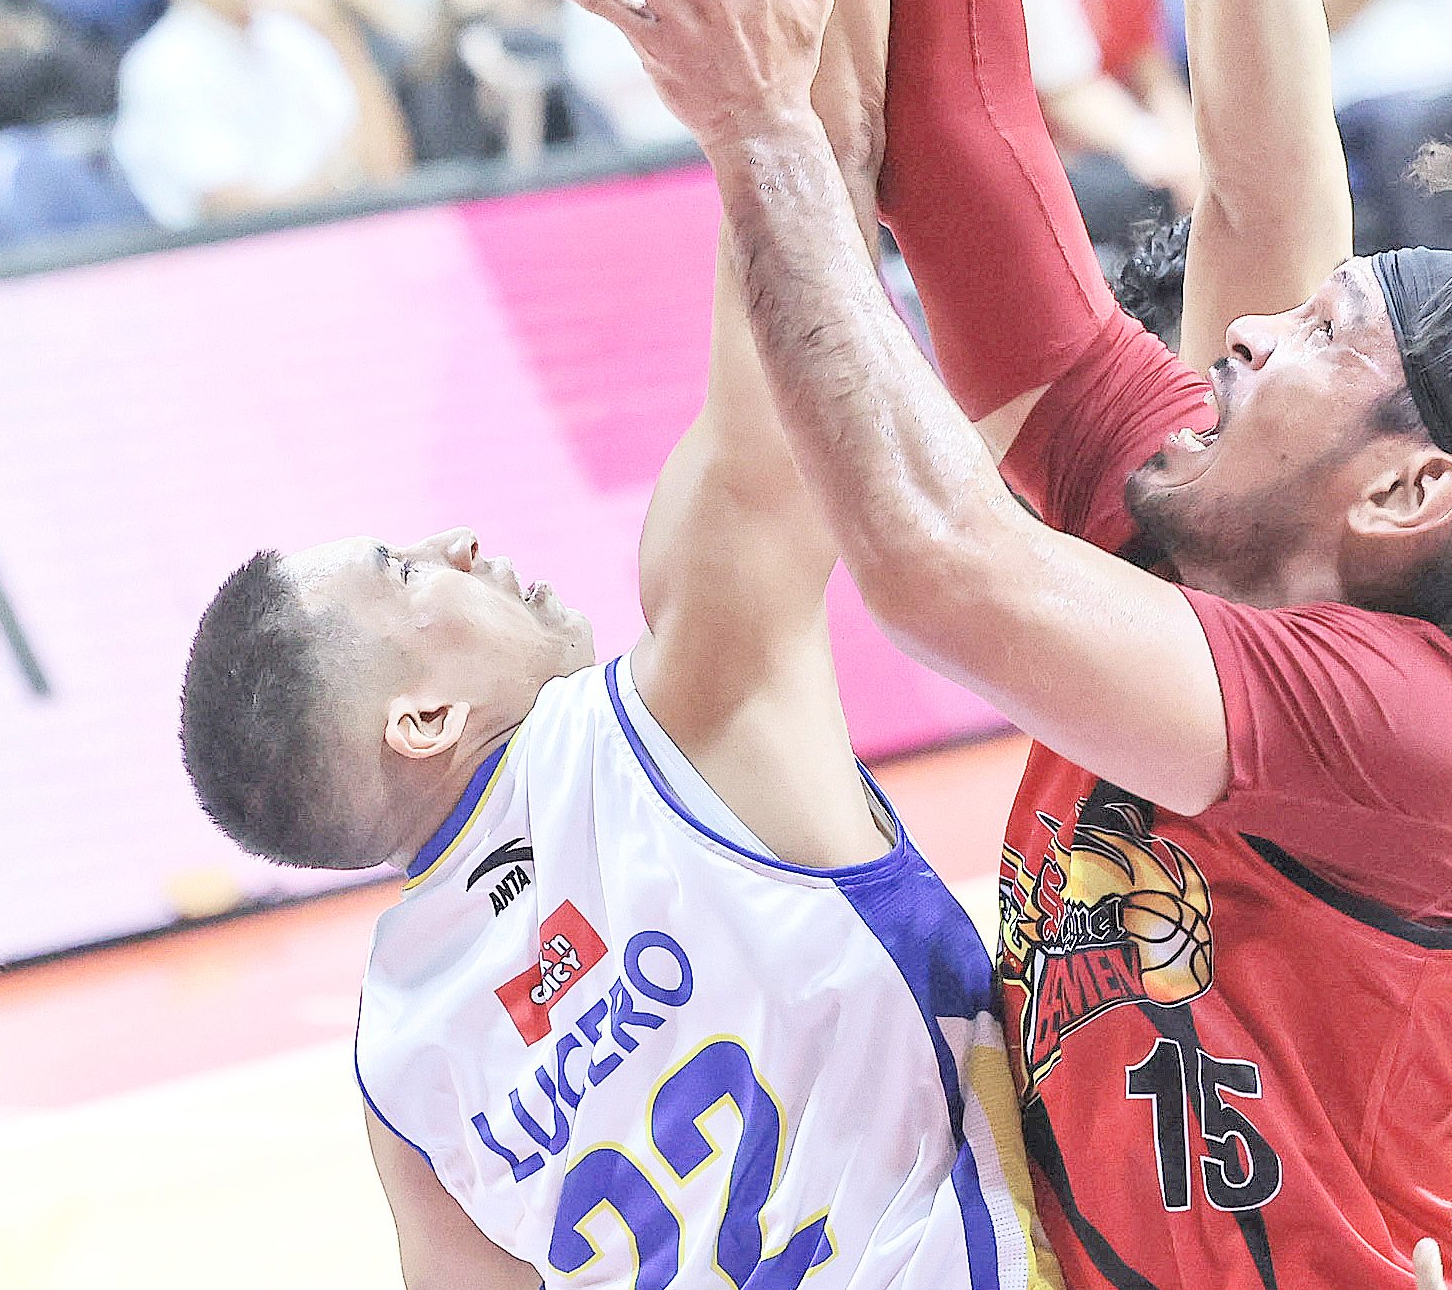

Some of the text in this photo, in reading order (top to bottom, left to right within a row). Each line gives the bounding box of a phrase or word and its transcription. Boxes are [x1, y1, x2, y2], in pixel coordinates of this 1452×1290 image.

[488, 864, 532, 918] ANTA
[470, 930, 694, 1183] LUCERO
[1124, 1036, 1283, 1212] 15
